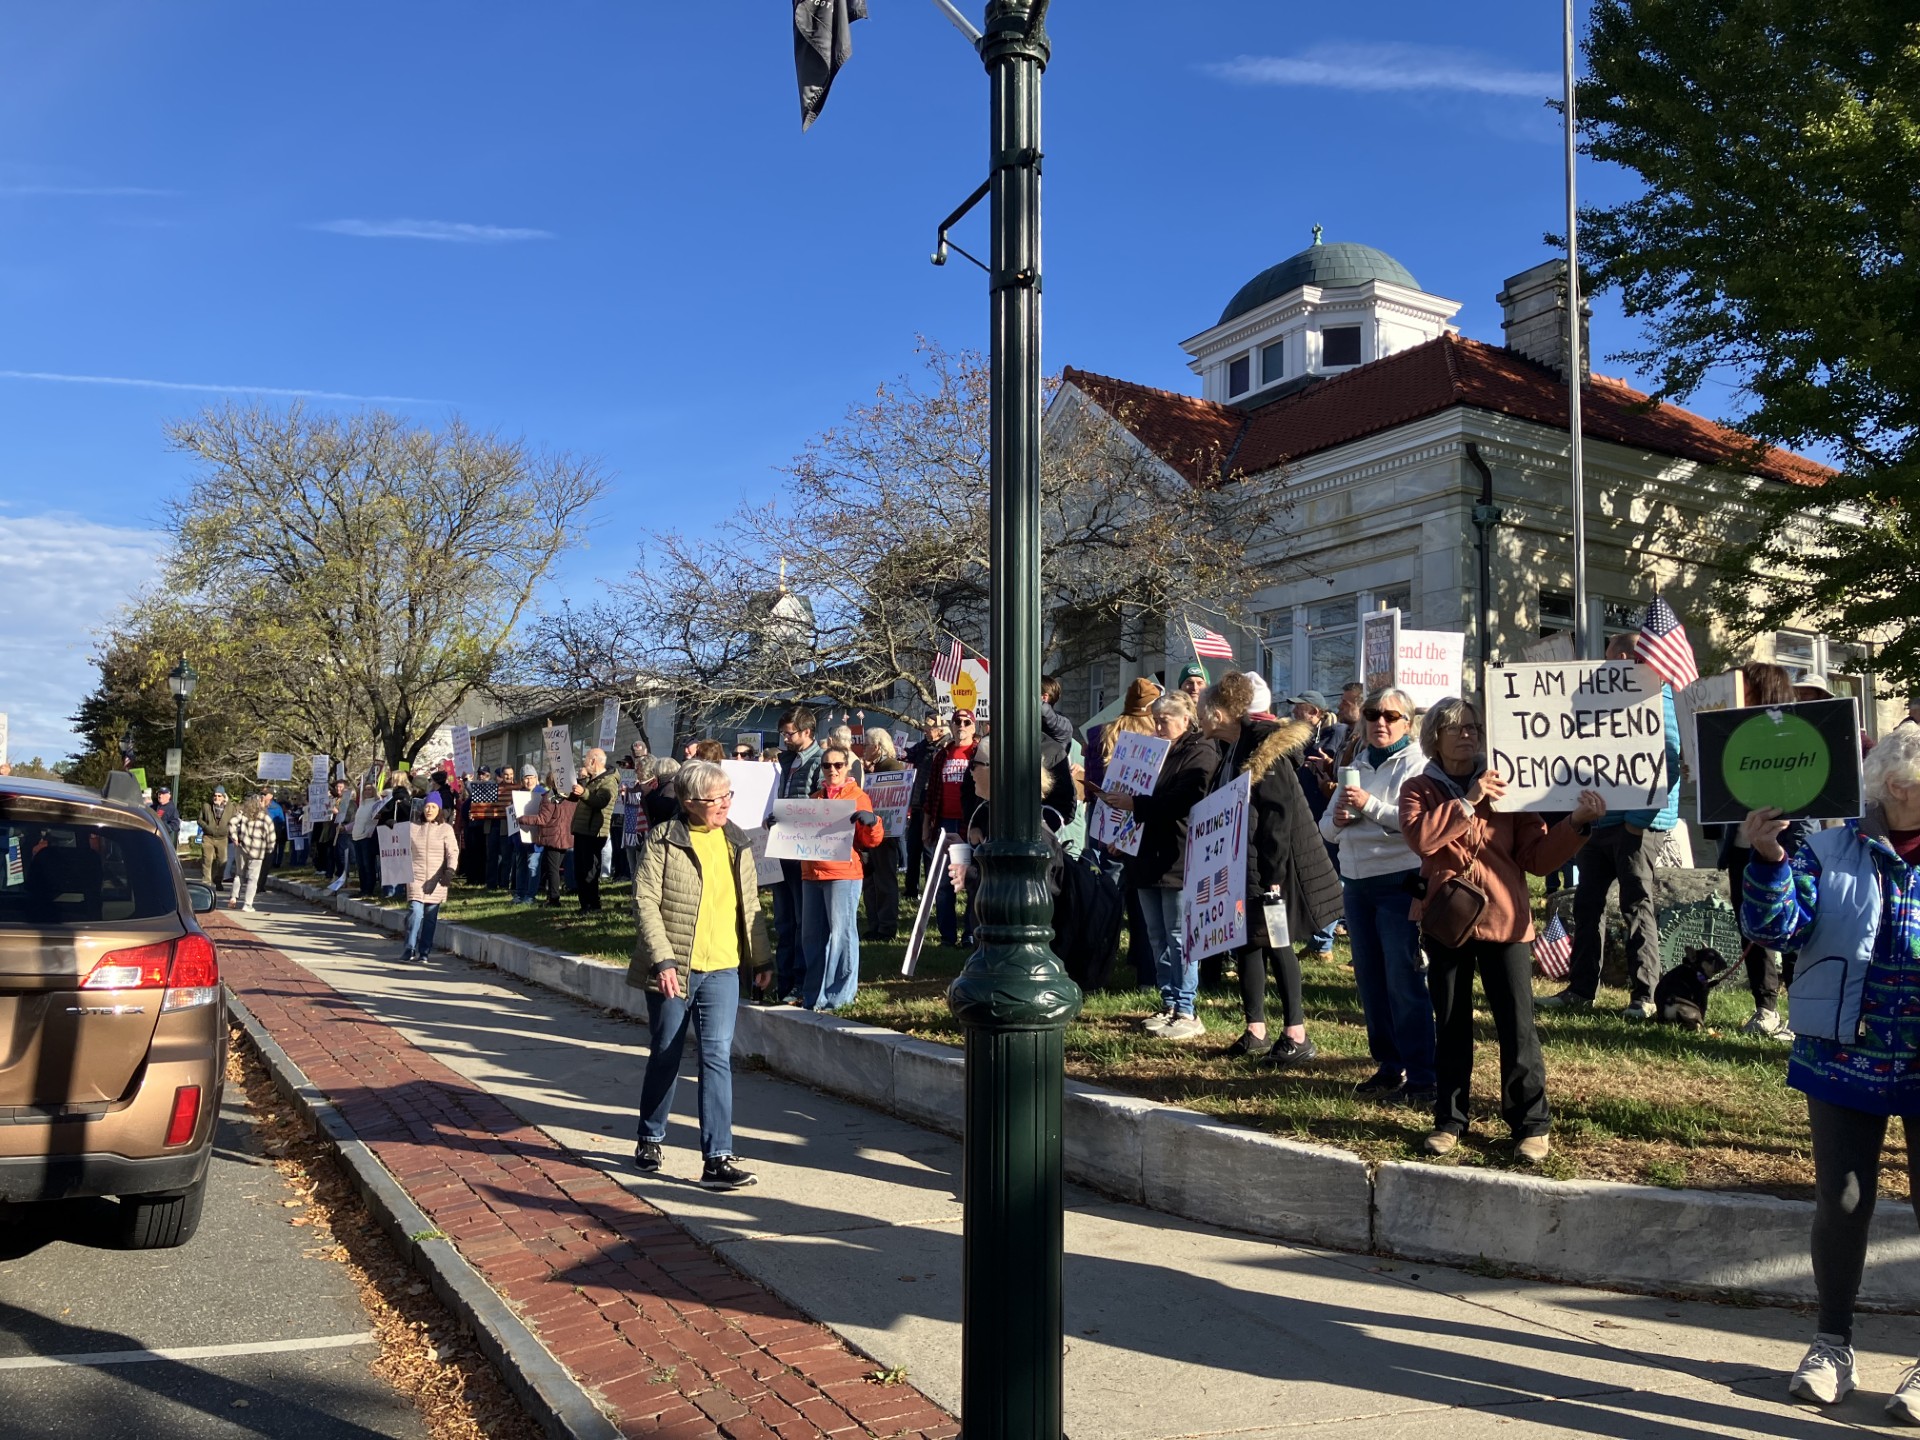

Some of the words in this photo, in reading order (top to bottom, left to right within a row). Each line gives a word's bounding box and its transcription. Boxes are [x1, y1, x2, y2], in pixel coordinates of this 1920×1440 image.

[1399, 642, 1422, 659] end
[1426, 643, 1446, 660] the
[1399, 667, 1449, 686] titution
[1504, 672, 1520, 699] I
[1533, 670, 1566, 697] AM
[1578, 667, 1642, 695] HERE
[939, 695, 950, 704] AND
[976, 708, 988, 718] ALL
[1512, 711, 1550, 740] TO
[1561, 707, 1660, 740] DEFEND
[1114, 745, 1127, 760] NO
[1739, 752, 1817, 772] Enough!
[1493, 747, 1665, 806] DEMOCRACY
[786, 804, 816, 815] Silence
[1204, 837, 1224, 862] X-47
[1199, 901, 1224, 928] TACO
[1203, 921, 1234, 951] A-HOLE
[66, 1006, 144, 1016] OUTBCK
